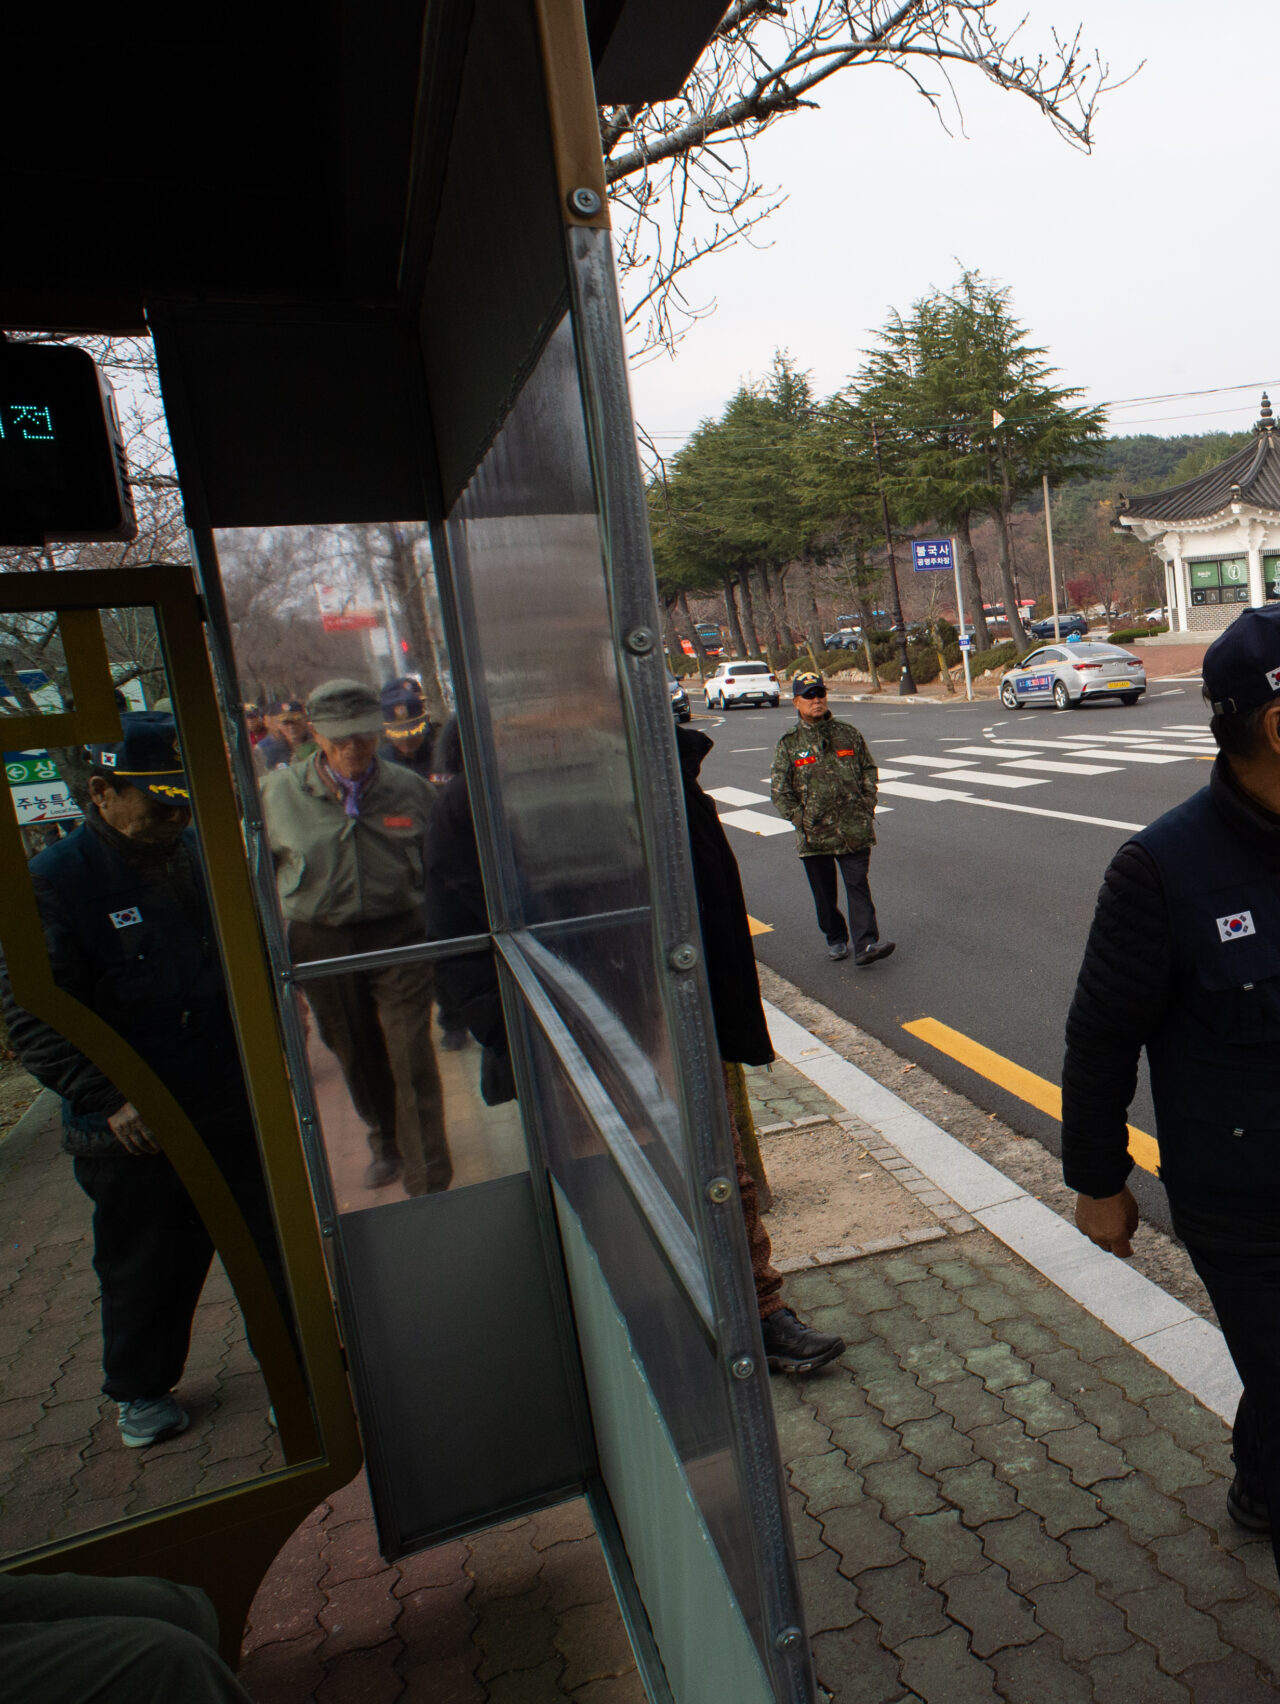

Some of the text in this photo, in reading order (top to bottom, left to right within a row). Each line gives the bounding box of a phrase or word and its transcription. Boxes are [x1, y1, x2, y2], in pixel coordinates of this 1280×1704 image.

[0, 405, 55, 440] 전
[916, 544, 949, 557] 불국사
[917, 557, 950, 566] 공영주차장
